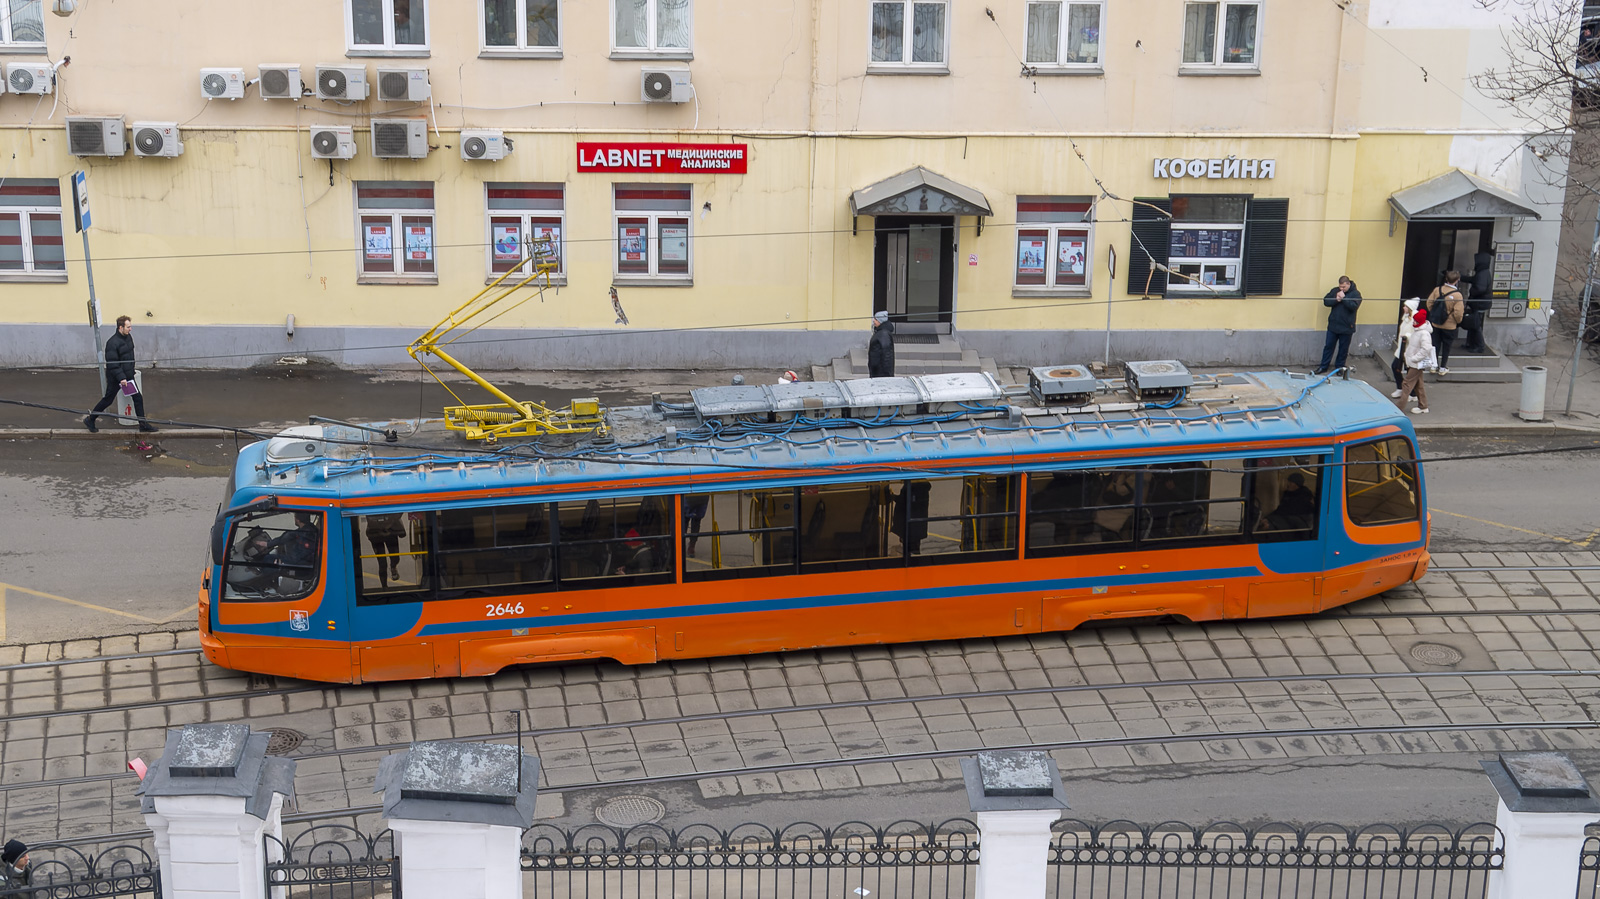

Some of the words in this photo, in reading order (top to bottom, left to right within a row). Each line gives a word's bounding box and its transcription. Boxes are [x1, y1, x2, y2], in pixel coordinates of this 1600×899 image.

[579, 149, 665, 167] LABNET
[667, 149, 743, 159] МЕДИЦИНСКИЕ
[680, 160, 730, 169] АНАЛИЗЫ
[1153, 155, 1276, 179] КОФЕЙНЯ
[485, 602, 524, 616] 2646
